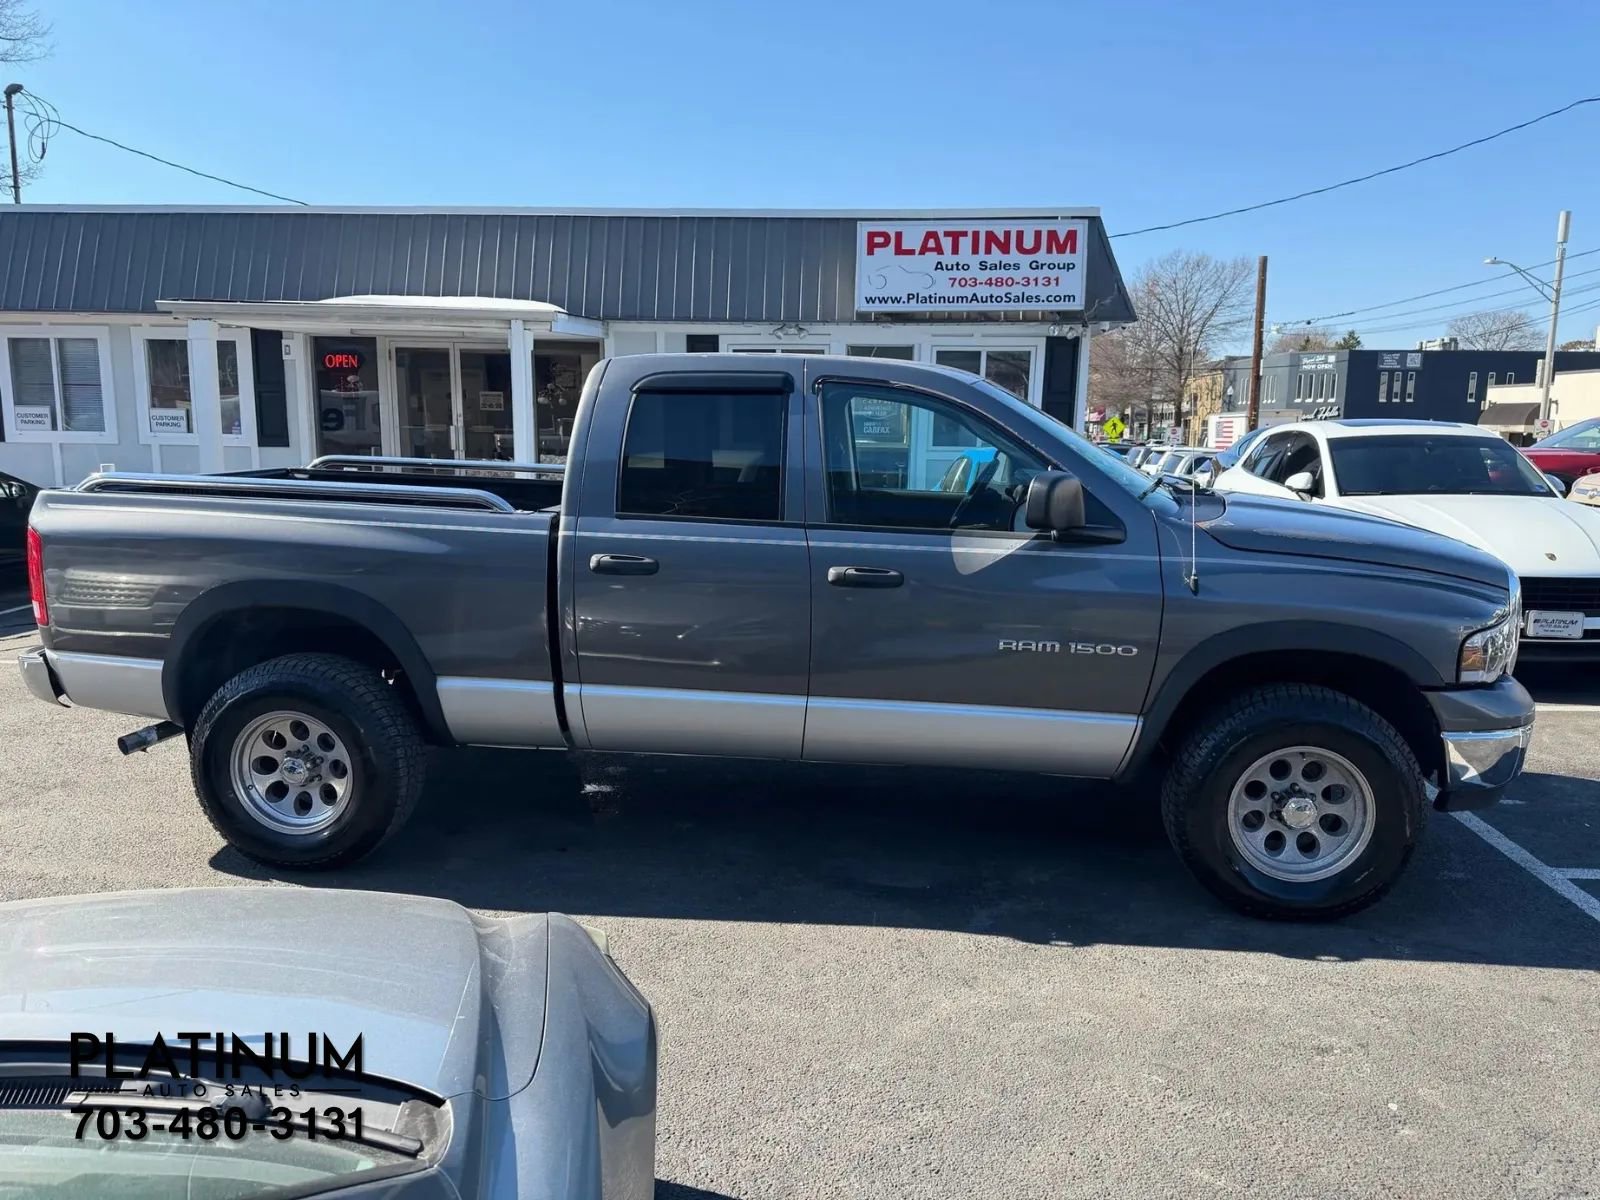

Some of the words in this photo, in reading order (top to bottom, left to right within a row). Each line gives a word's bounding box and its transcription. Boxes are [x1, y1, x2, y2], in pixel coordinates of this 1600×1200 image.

[866, 229, 1078, 256] PLATINUM
[934, 261, 970, 272] Auto
[978, 260, 1021, 271] Sales
[1029, 260, 1076, 273] Group
[948, 275, 1060, 288] 703-480-3131
[865, 291, 1076, 305] www.PlatinumAutoSales.com
[325, 354, 358, 368] OPEN
[998, 639, 1060, 653] RAM
[1068, 641, 1138, 656] 1500
